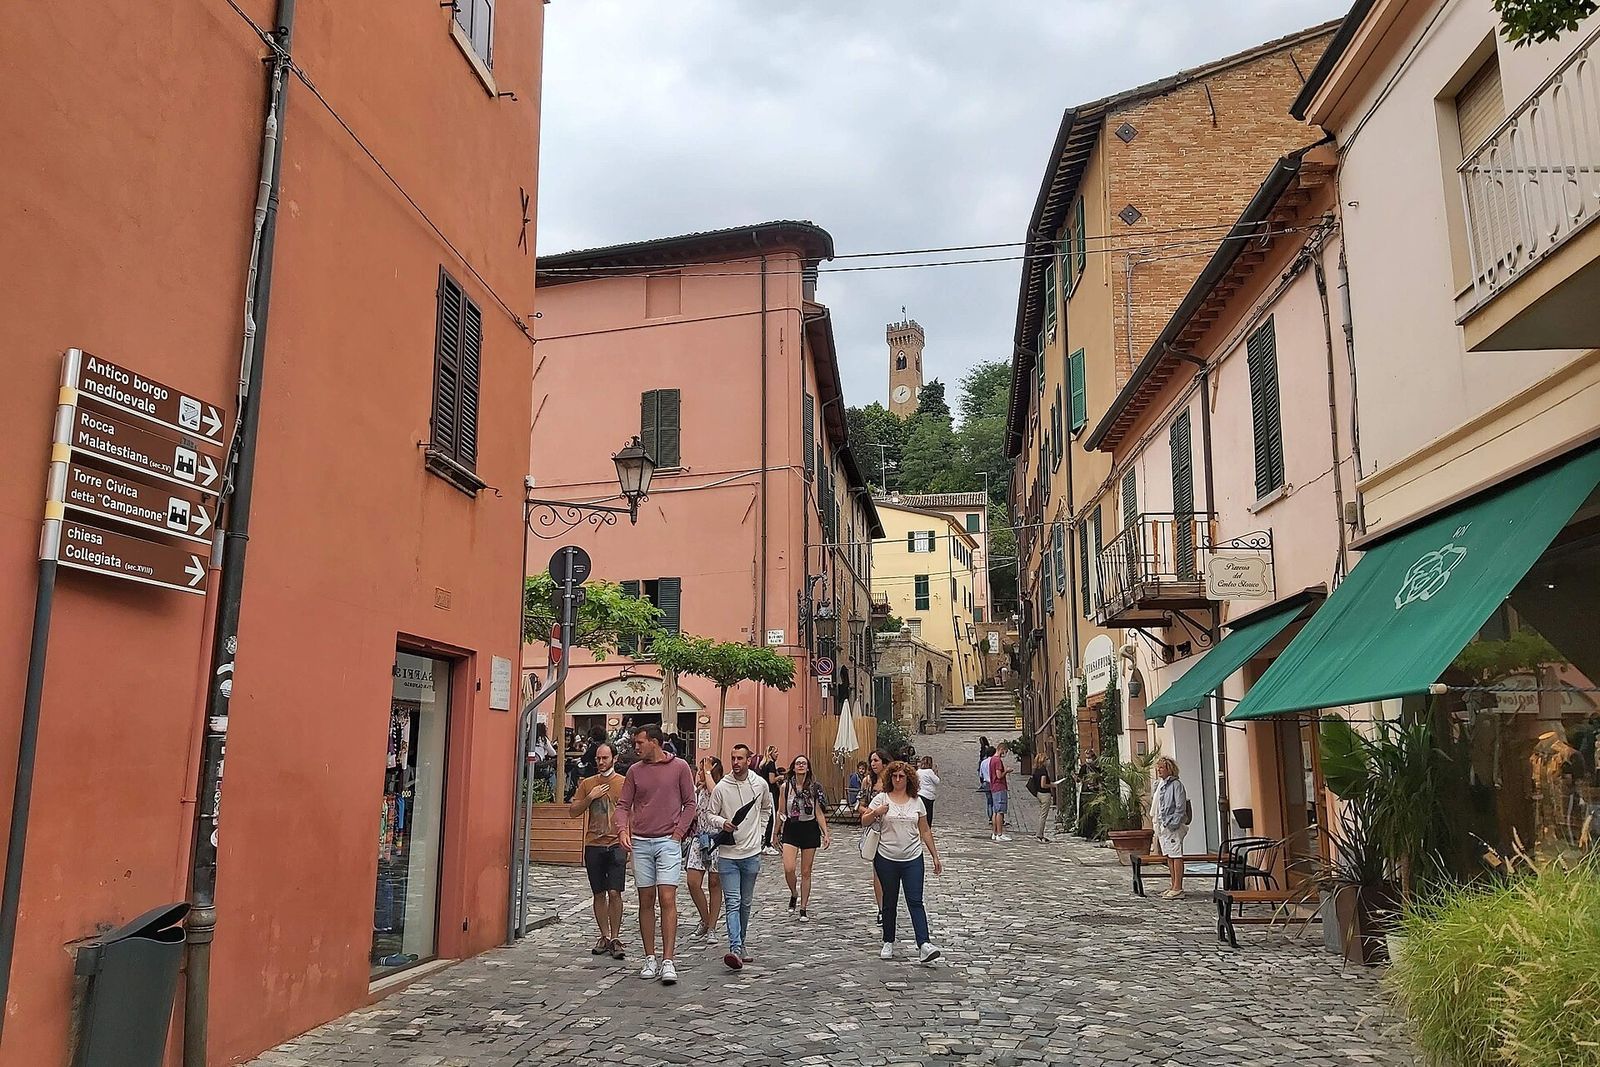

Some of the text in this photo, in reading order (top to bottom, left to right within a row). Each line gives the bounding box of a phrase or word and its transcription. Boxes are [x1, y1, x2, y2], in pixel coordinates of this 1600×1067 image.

[87, 357, 168, 400] Antico borgo
[84, 378, 156, 414] medioevale
[81, 412, 115, 435] Rocca
[79, 431, 149, 465] Malatestiana
[73, 468, 138, 499] Torre Civica
[71, 489, 168, 522] detta "Campanone"
[67, 527, 103, 545] chiesa
[65, 545, 121, 568] Collegiata
[586, 691, 603, 708] La
